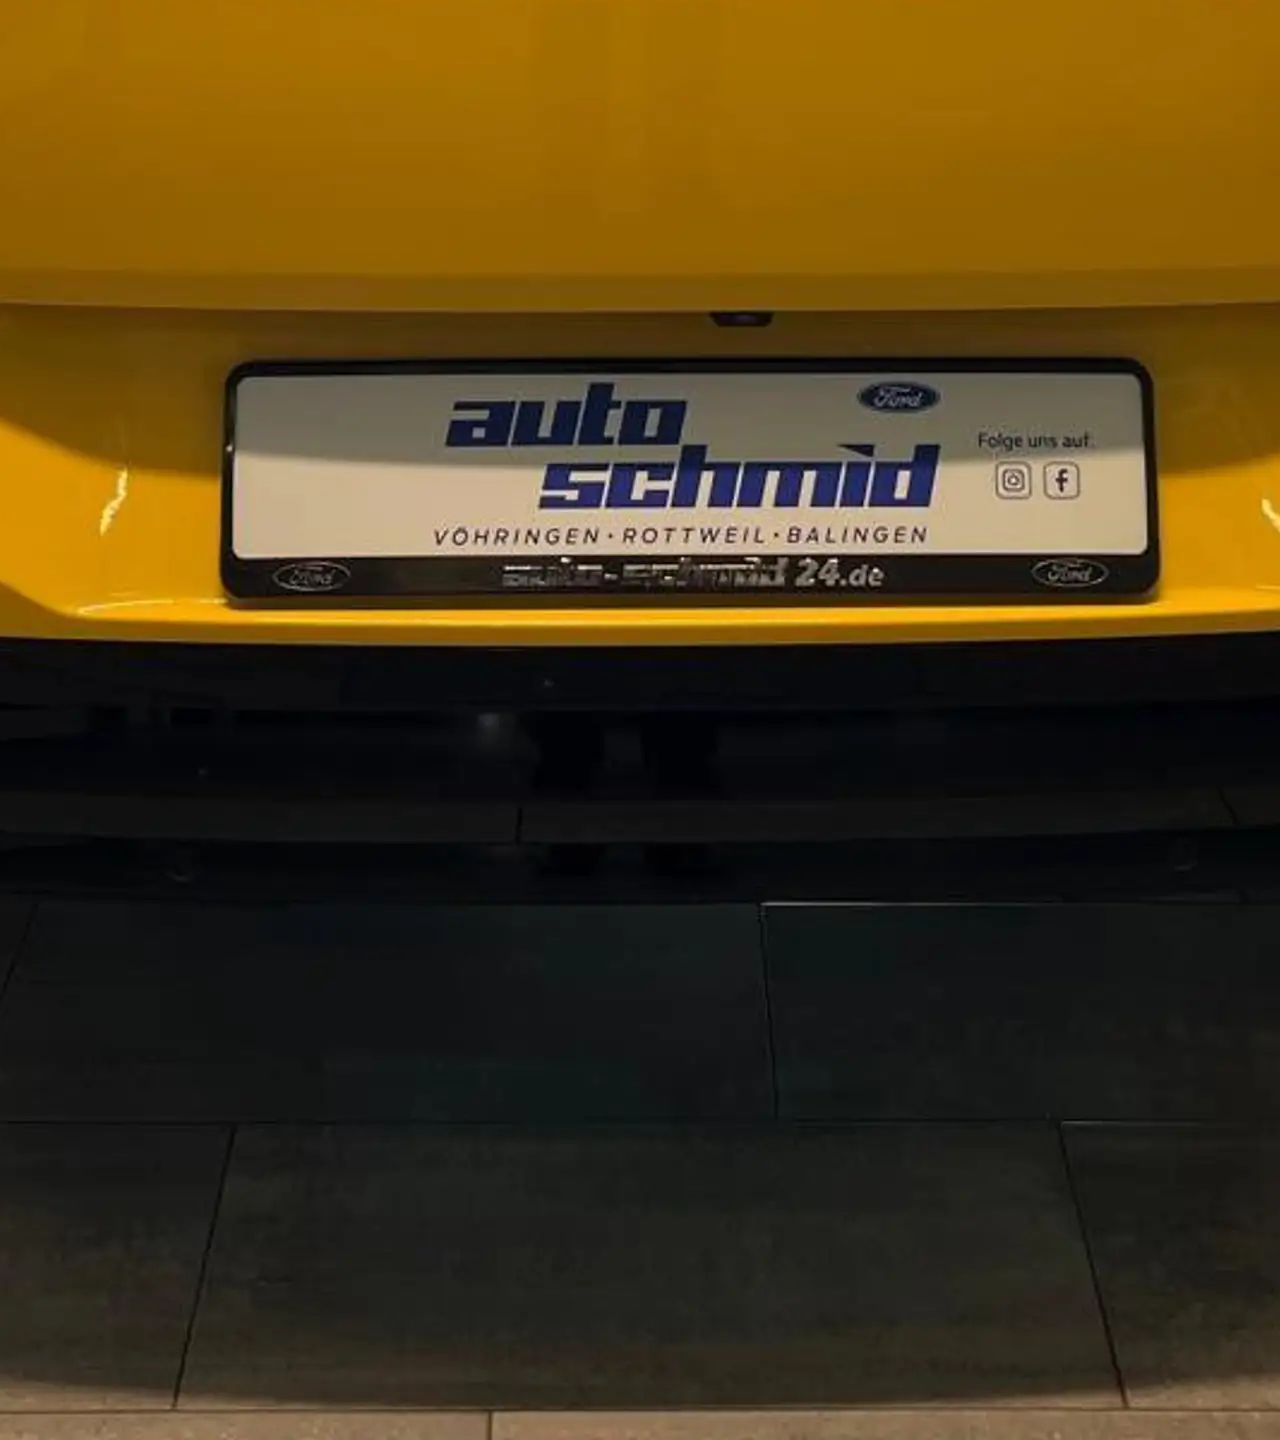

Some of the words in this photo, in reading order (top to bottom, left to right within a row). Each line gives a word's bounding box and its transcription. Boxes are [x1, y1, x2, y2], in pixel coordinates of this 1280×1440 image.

[445, 382, 688, 446] auto
[978, 430, 1023, 452] Folge
[1028, 434, 1058, 449] uns
[539, 444, 942, 509] schmid
